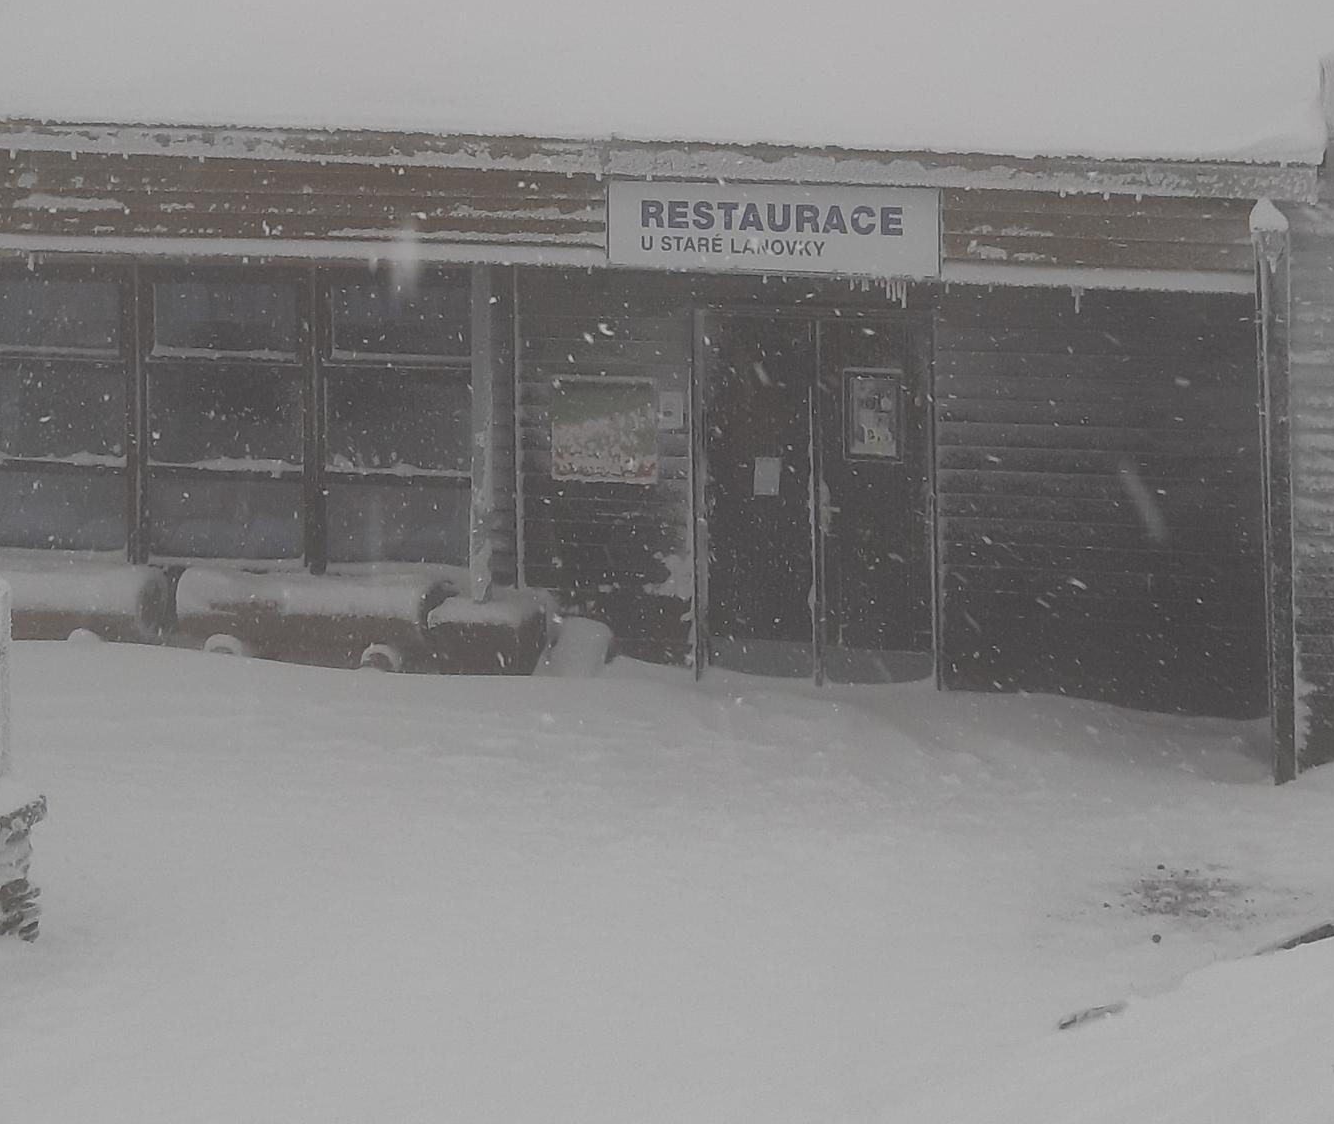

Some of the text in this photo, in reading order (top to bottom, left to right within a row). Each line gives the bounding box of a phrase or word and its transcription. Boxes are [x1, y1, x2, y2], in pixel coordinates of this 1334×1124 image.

[641, 199, 904, 237] RESTAURACE
[641, 235, 654, 251] U
[660, 233, 724, 254] STARÉ
